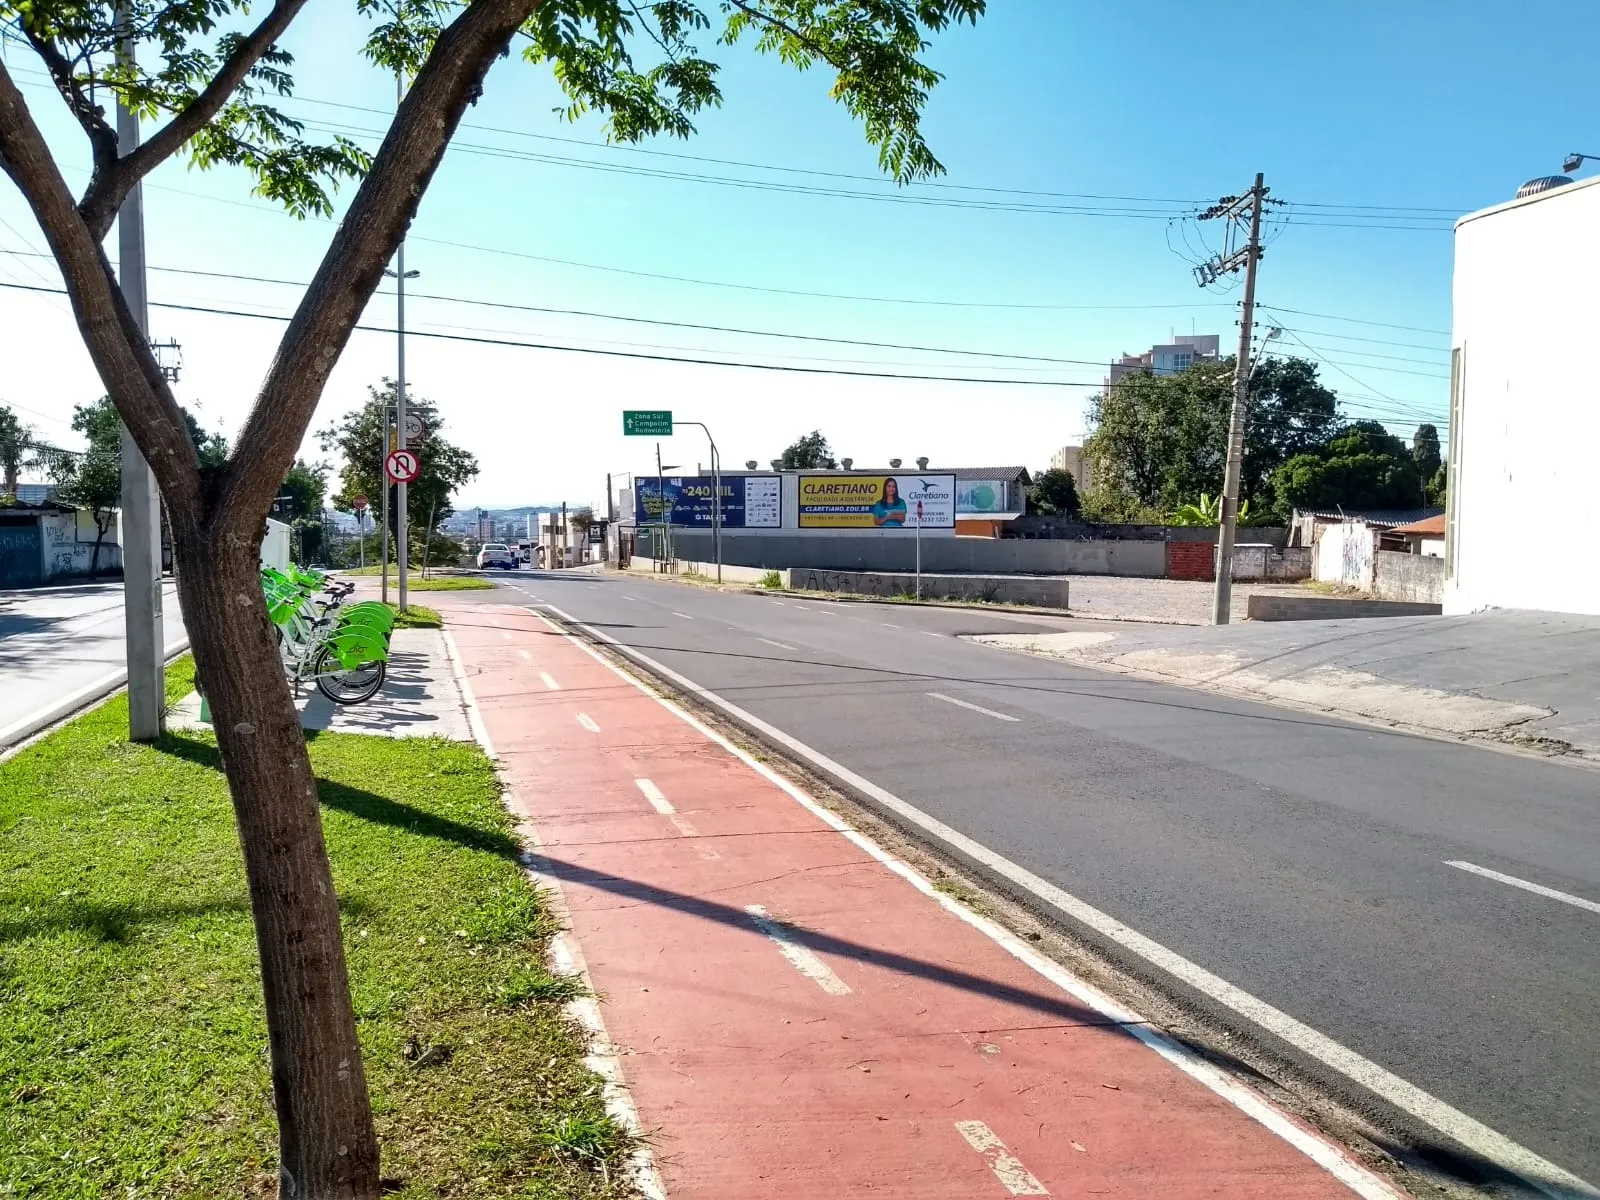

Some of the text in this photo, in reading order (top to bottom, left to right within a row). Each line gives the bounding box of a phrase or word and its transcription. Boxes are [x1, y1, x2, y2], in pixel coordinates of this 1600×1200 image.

[634, 420, 669, 428] Campolim
[803, 483, 878, 495] CLARETIANO
[908, 491, 949, 500] Claretiano
